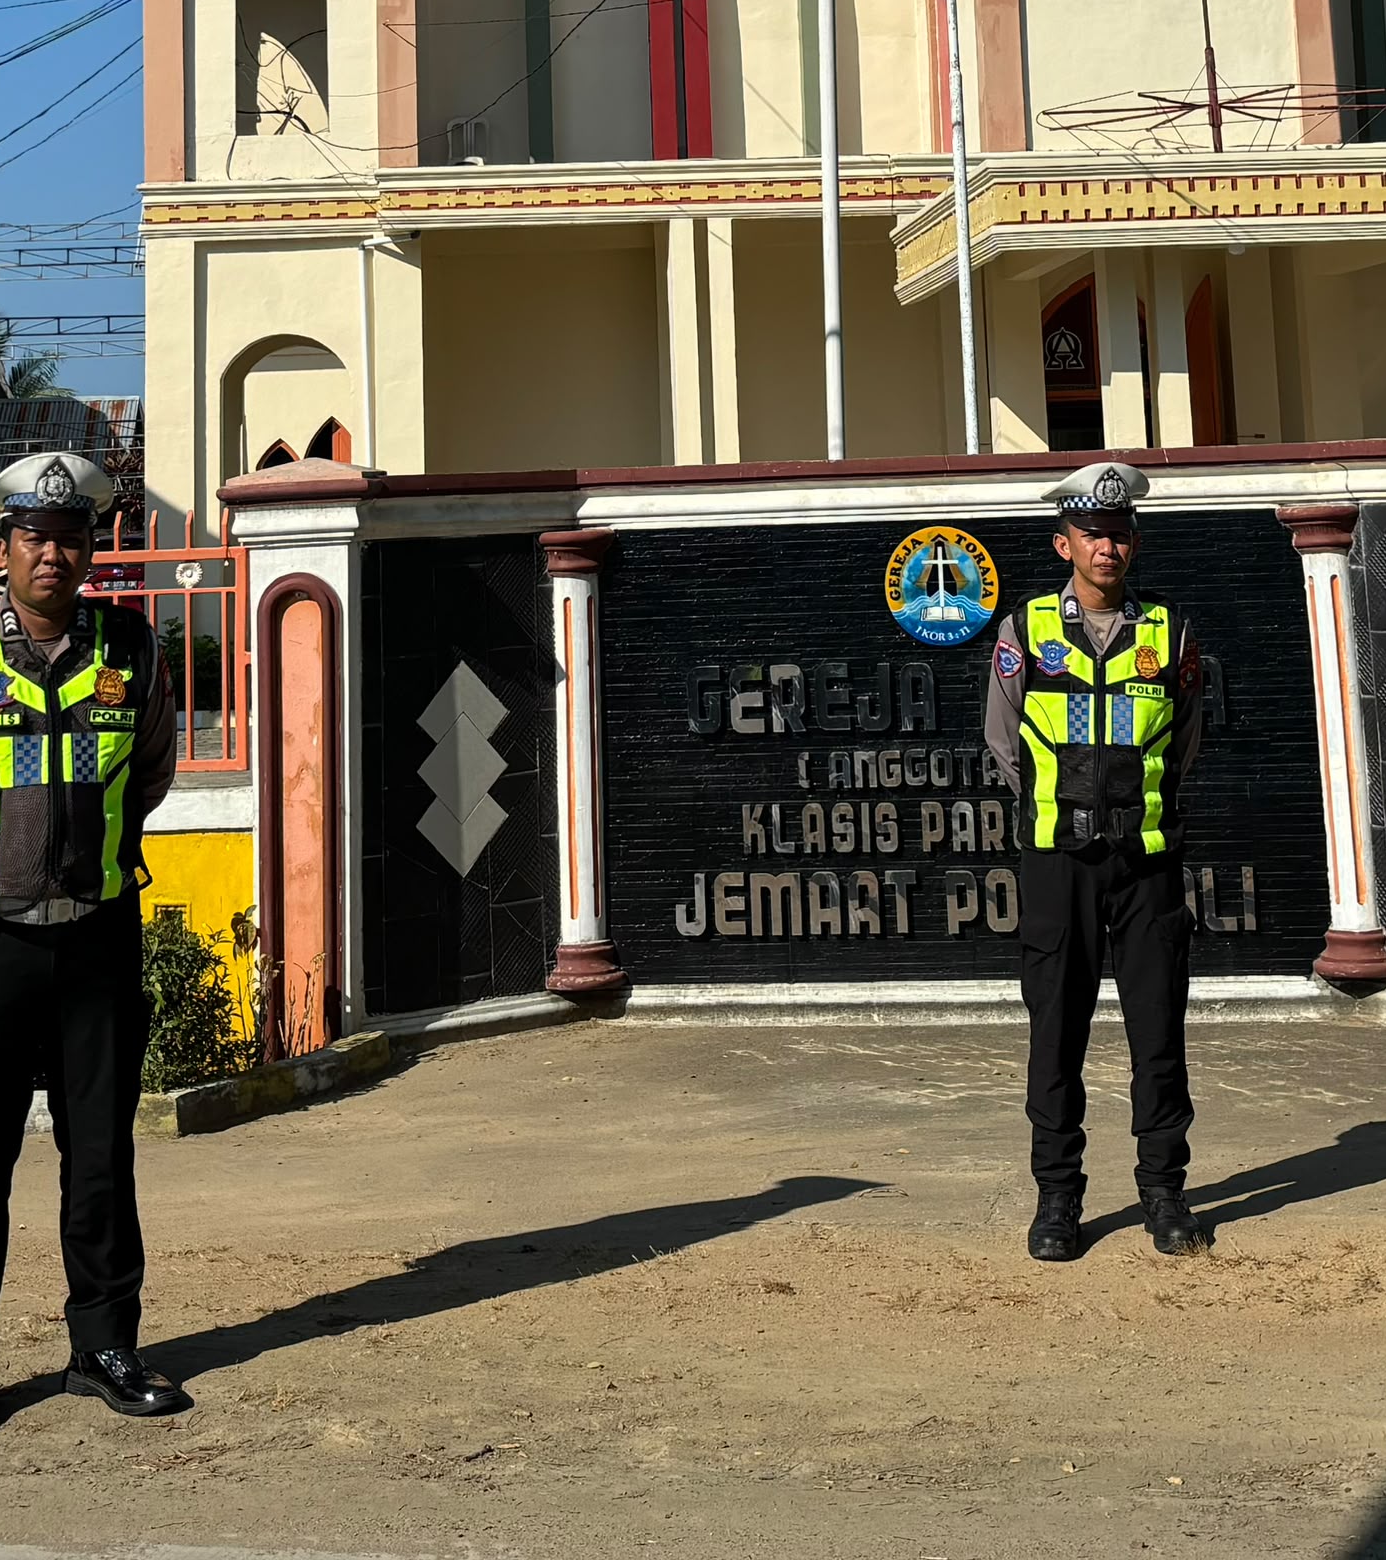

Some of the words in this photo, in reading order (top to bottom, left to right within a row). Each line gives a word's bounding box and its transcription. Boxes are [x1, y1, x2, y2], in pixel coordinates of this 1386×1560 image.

[889, 537, 924, 601] GEREJA
[955, 534, 994, 600] TORAJA
[921, 628, 946, 641] KOR
[686, 662, 938, 734] GEREJA
[1128, 684, 1162, 696] POLRI
[92, 711, 133, 723] POLRI
[741, 802, 899, 854] KLASIS
[675, 869, 916, 937] JEMAAT
